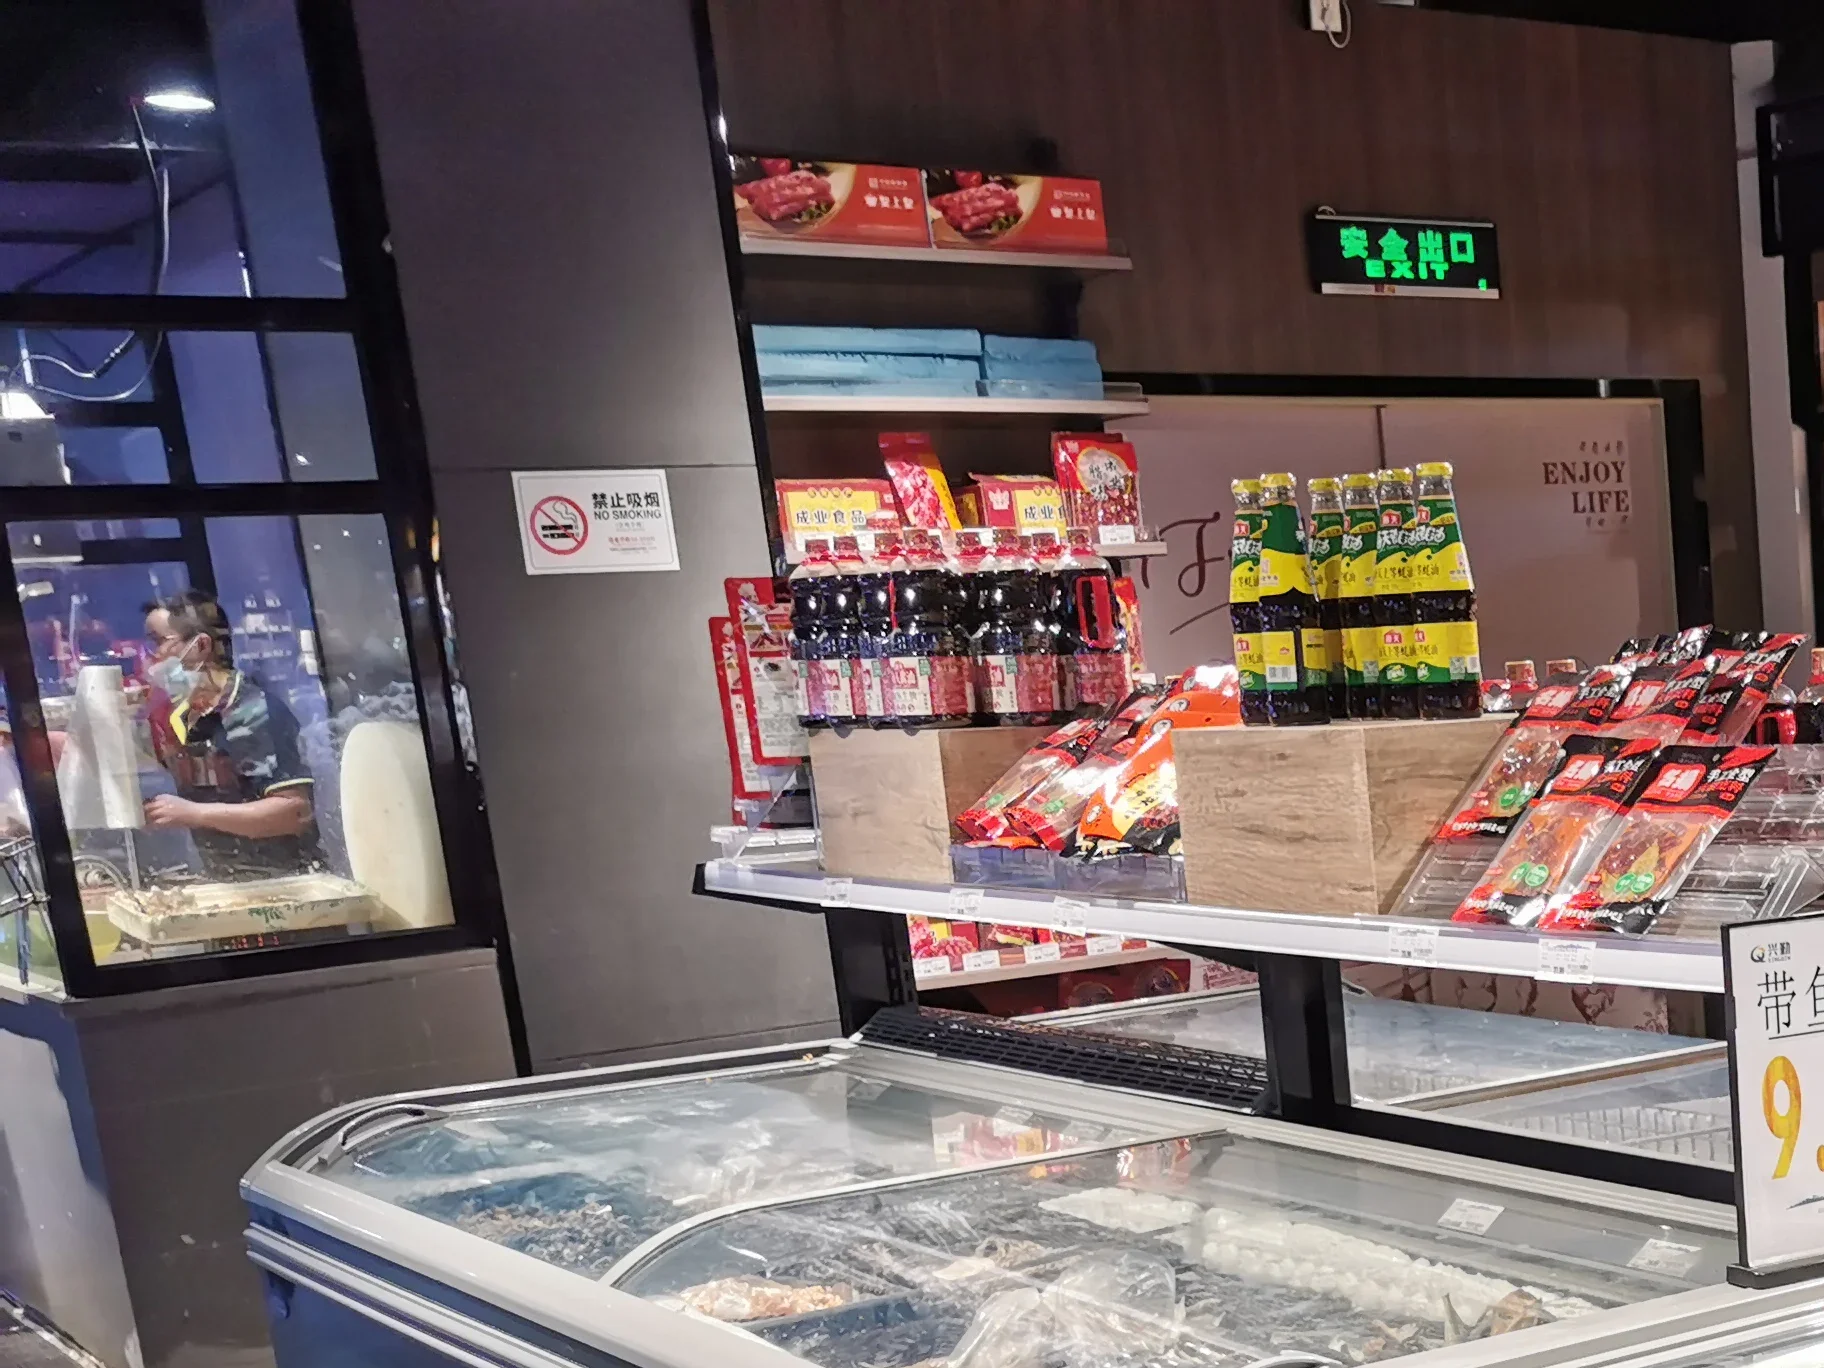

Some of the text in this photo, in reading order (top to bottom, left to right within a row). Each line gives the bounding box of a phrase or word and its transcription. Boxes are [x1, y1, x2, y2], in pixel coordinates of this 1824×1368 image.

[1340, 226, 1475, 263] 安全出口
[1365, 259, 1449, 280] EXIT
[1542, 461, 1625, 485] ENJOY
[592, 492, 660, 509] 禁止吸烟
[1572, 490, 1630, 514] LIFE
[594, 509, 662, 521] NO SMOKING
[796, 510, 867, 525] 成业食品
